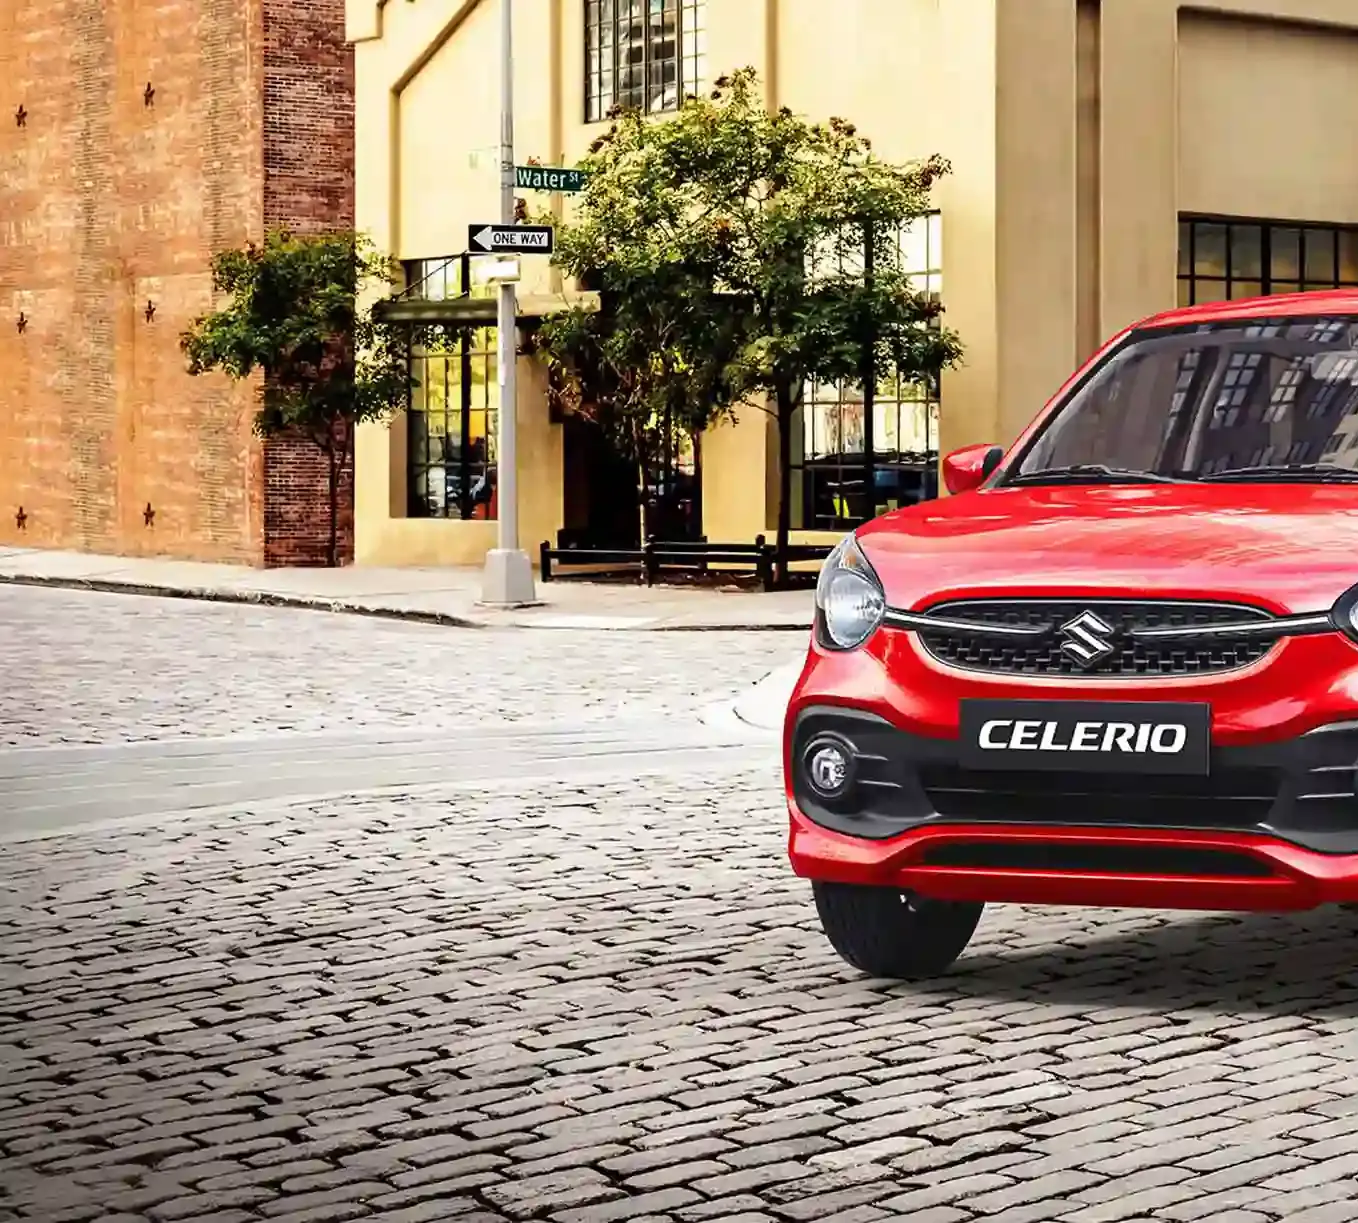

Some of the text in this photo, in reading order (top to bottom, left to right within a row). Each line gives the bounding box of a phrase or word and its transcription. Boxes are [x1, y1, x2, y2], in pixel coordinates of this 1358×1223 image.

[518, 169, 579, 188] Water St
[493, 233, 545, 245] ONE WAY
[979, 719, 1187, 753] CELERIO
